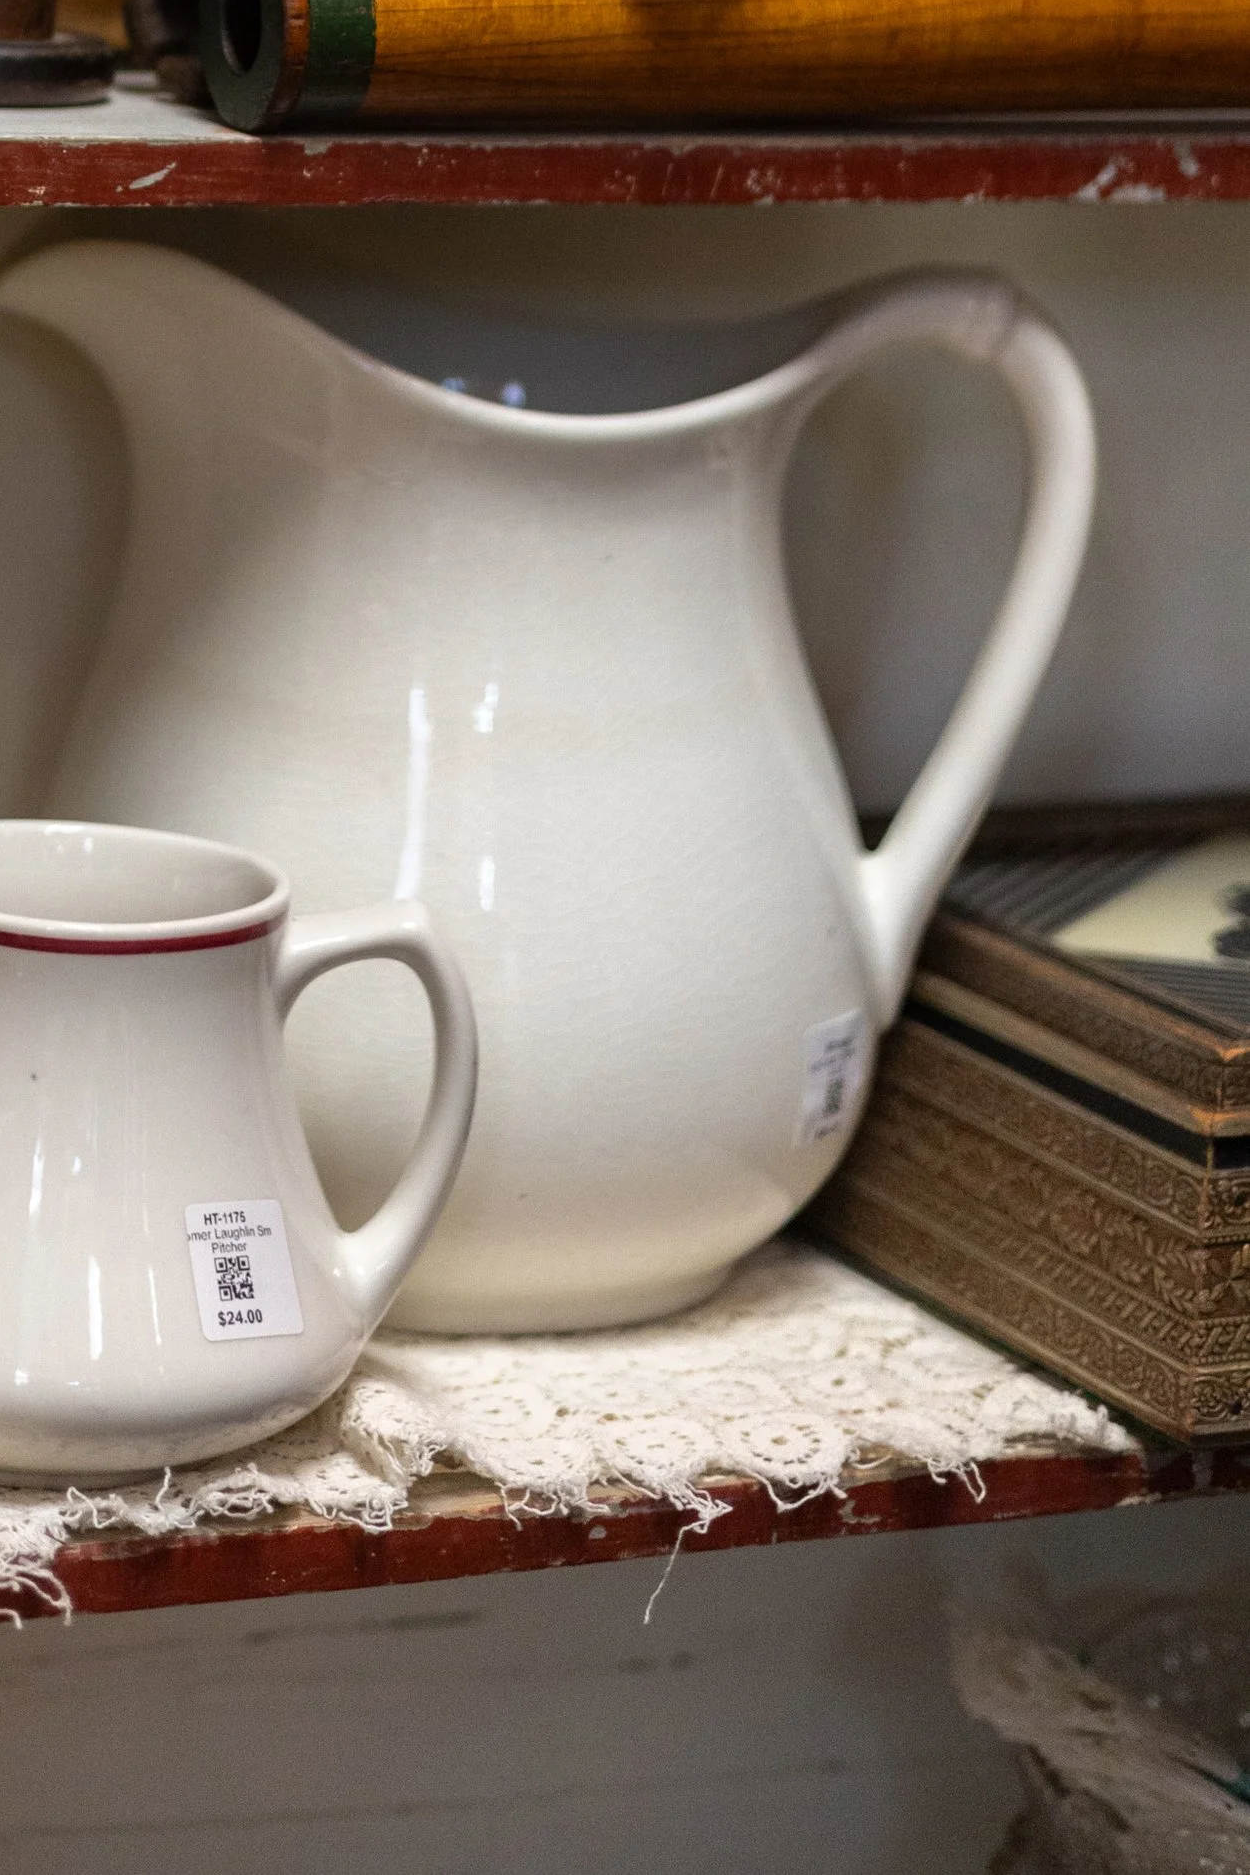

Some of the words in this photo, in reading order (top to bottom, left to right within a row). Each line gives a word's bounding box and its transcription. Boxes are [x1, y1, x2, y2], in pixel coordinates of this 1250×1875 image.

[203, 1211, 246, 1226] HT-1175
[214, 1226, 255, 1241] Laughlin
[256, 1225, 272, 1237] Sm
[211, 1242, 247, 1254] Pitcher
[217, 1309, 263, 1328] $24.00
